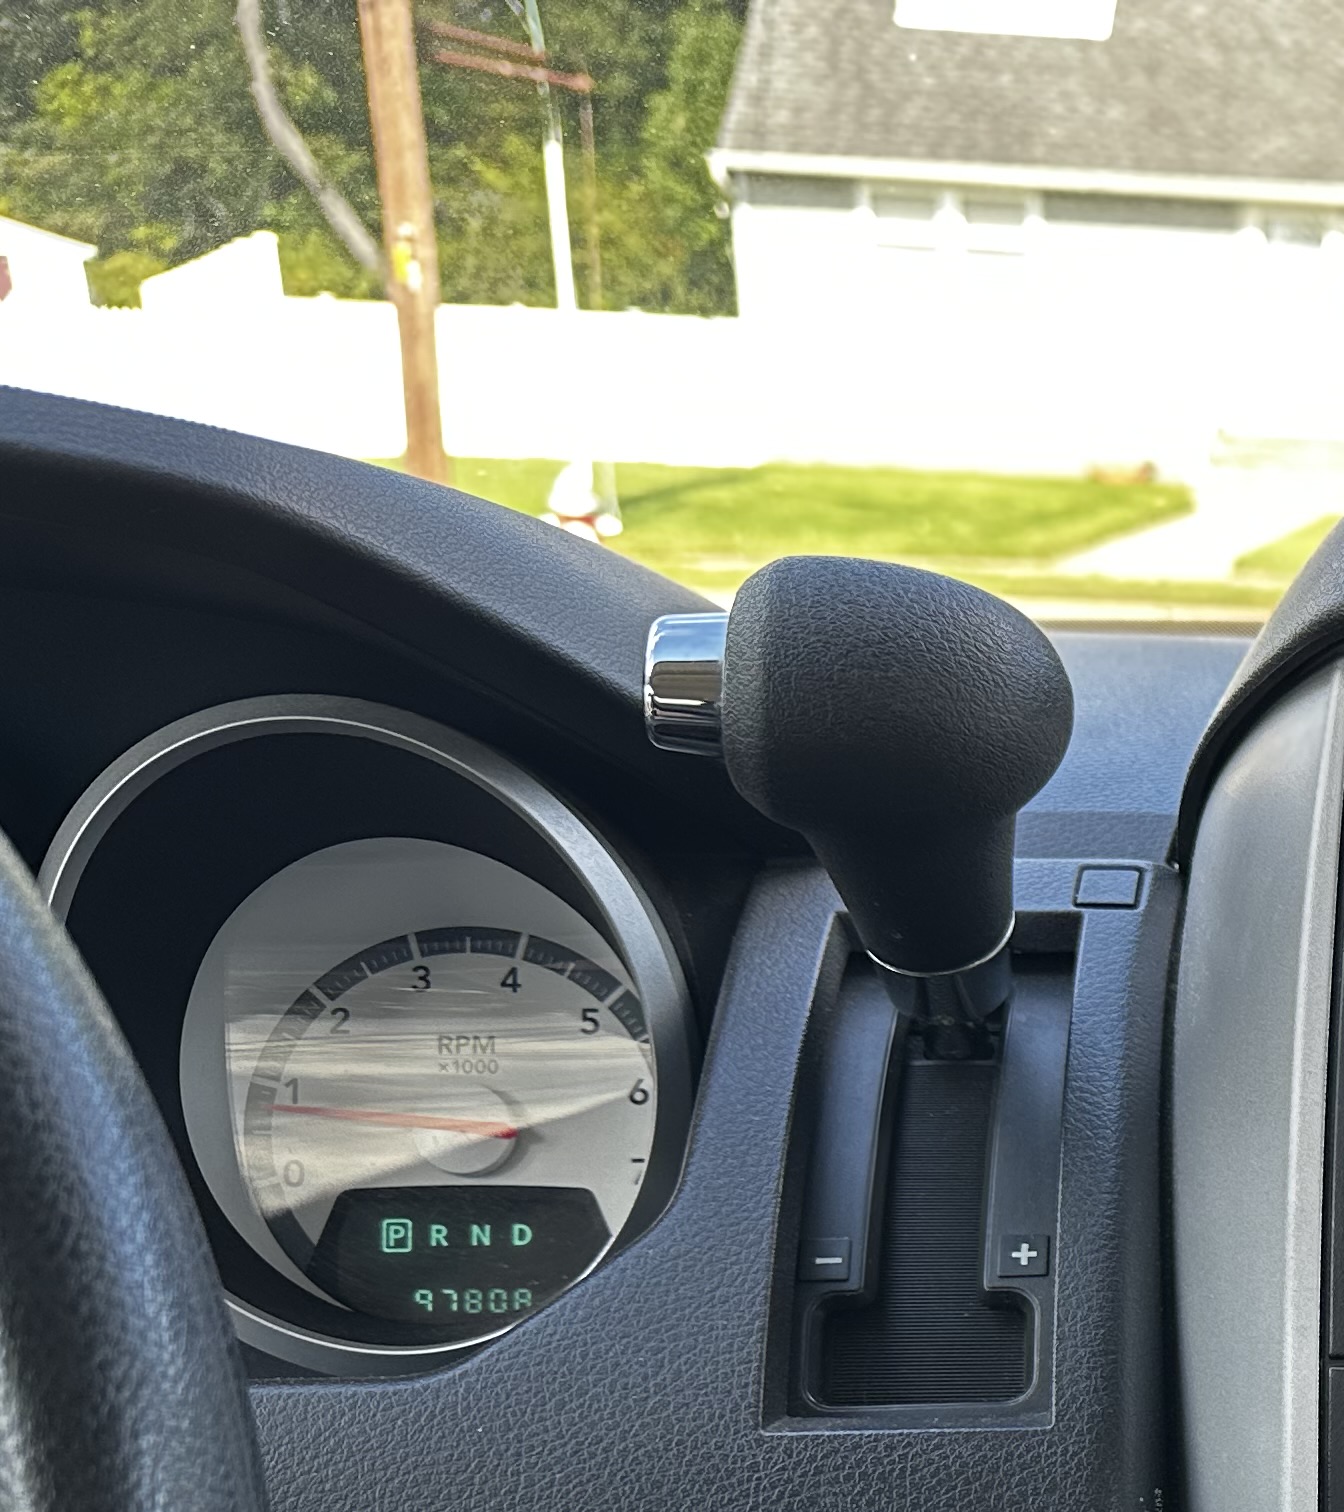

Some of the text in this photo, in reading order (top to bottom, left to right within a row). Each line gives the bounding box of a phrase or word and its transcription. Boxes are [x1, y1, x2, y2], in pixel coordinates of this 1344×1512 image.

[411, 965, 432, 992] 3
[500, 966, 522, 993] 4
[329, 1006, 351, 1035] 2
[580, 1008, 600, 1035] 5
[437, 1034, 497, 1055] RPM
[284, 1077, 299, 1105] 1
[628, 1078, 649, 1106] 6
[283, 1159, 305, 1188] 0
[388, 1222, 533, 1247] P R N D
